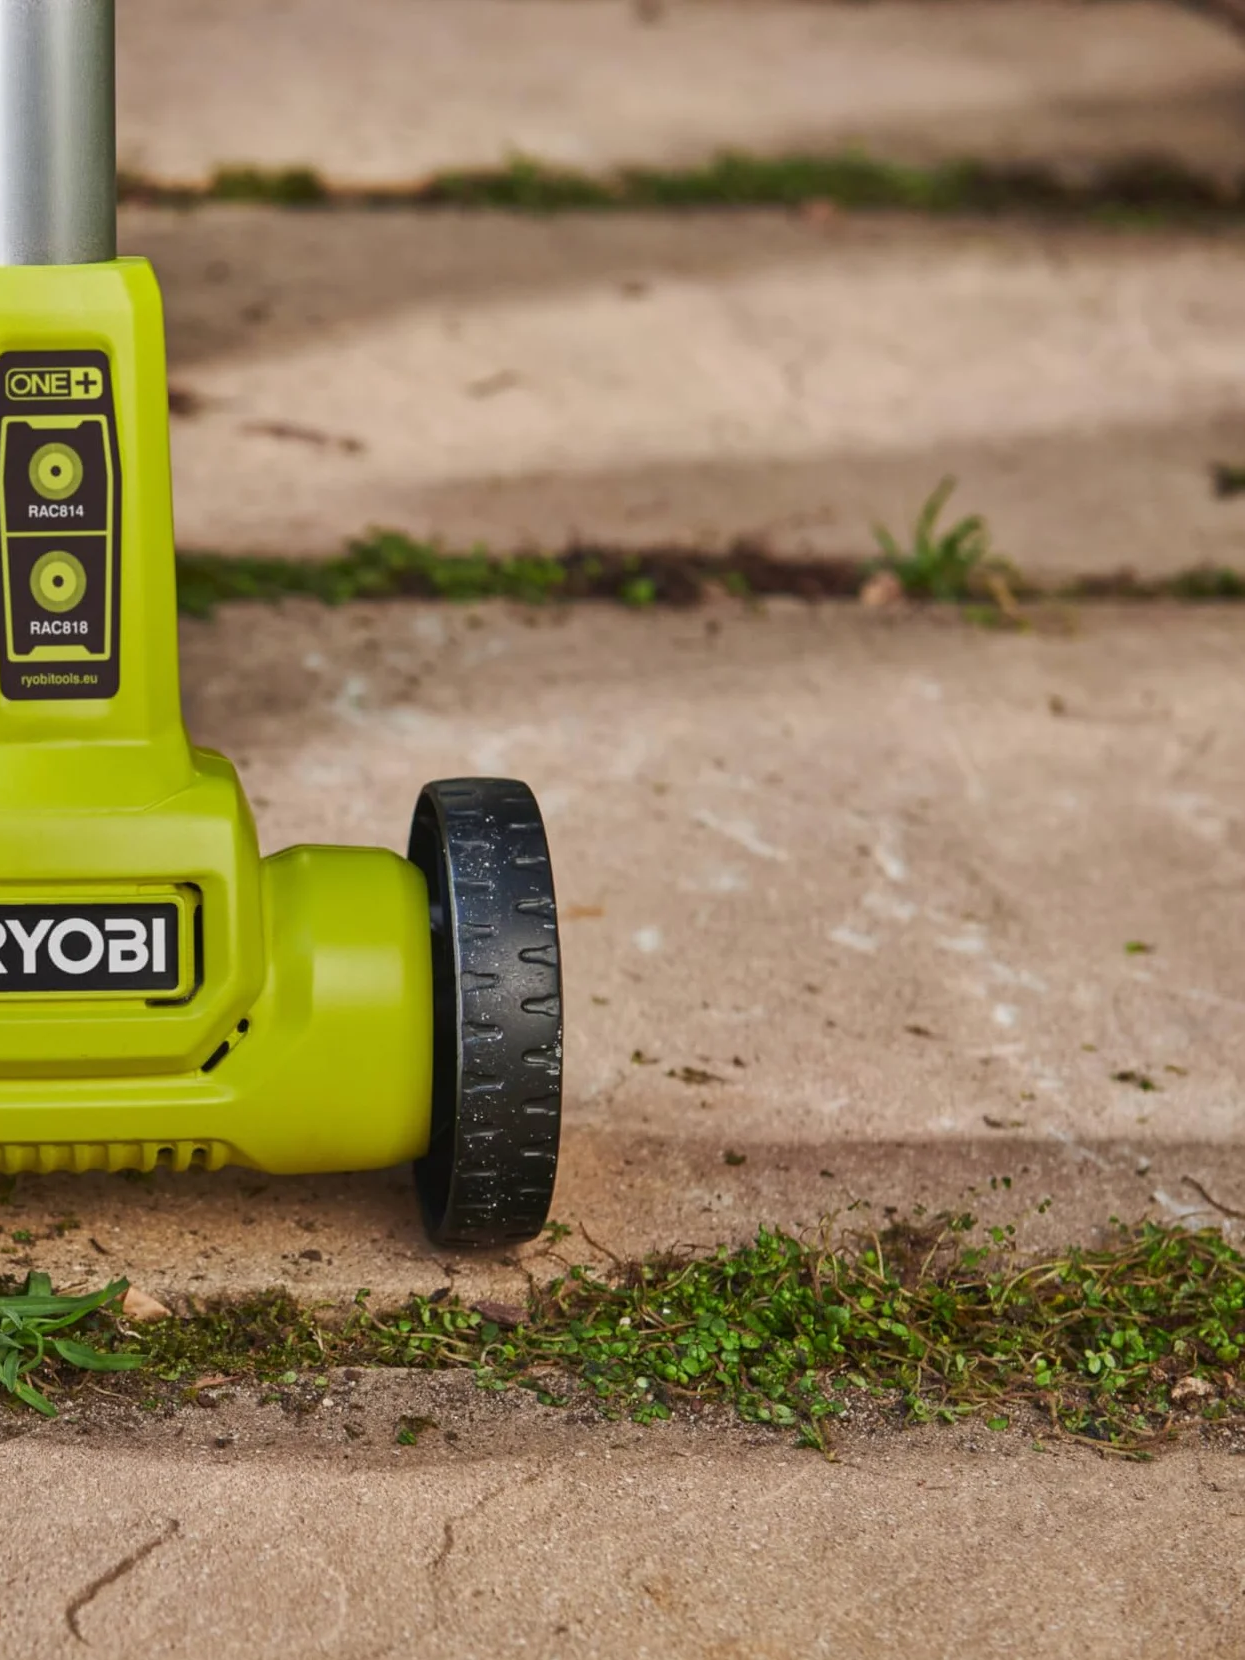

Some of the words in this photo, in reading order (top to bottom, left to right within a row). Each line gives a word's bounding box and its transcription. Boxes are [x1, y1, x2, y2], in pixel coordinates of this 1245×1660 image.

[28, 504, 84, 518] RAC814
[30, 620, 89, 635] RAC818
[21, 672, 98, 688] ryobitools.eu
